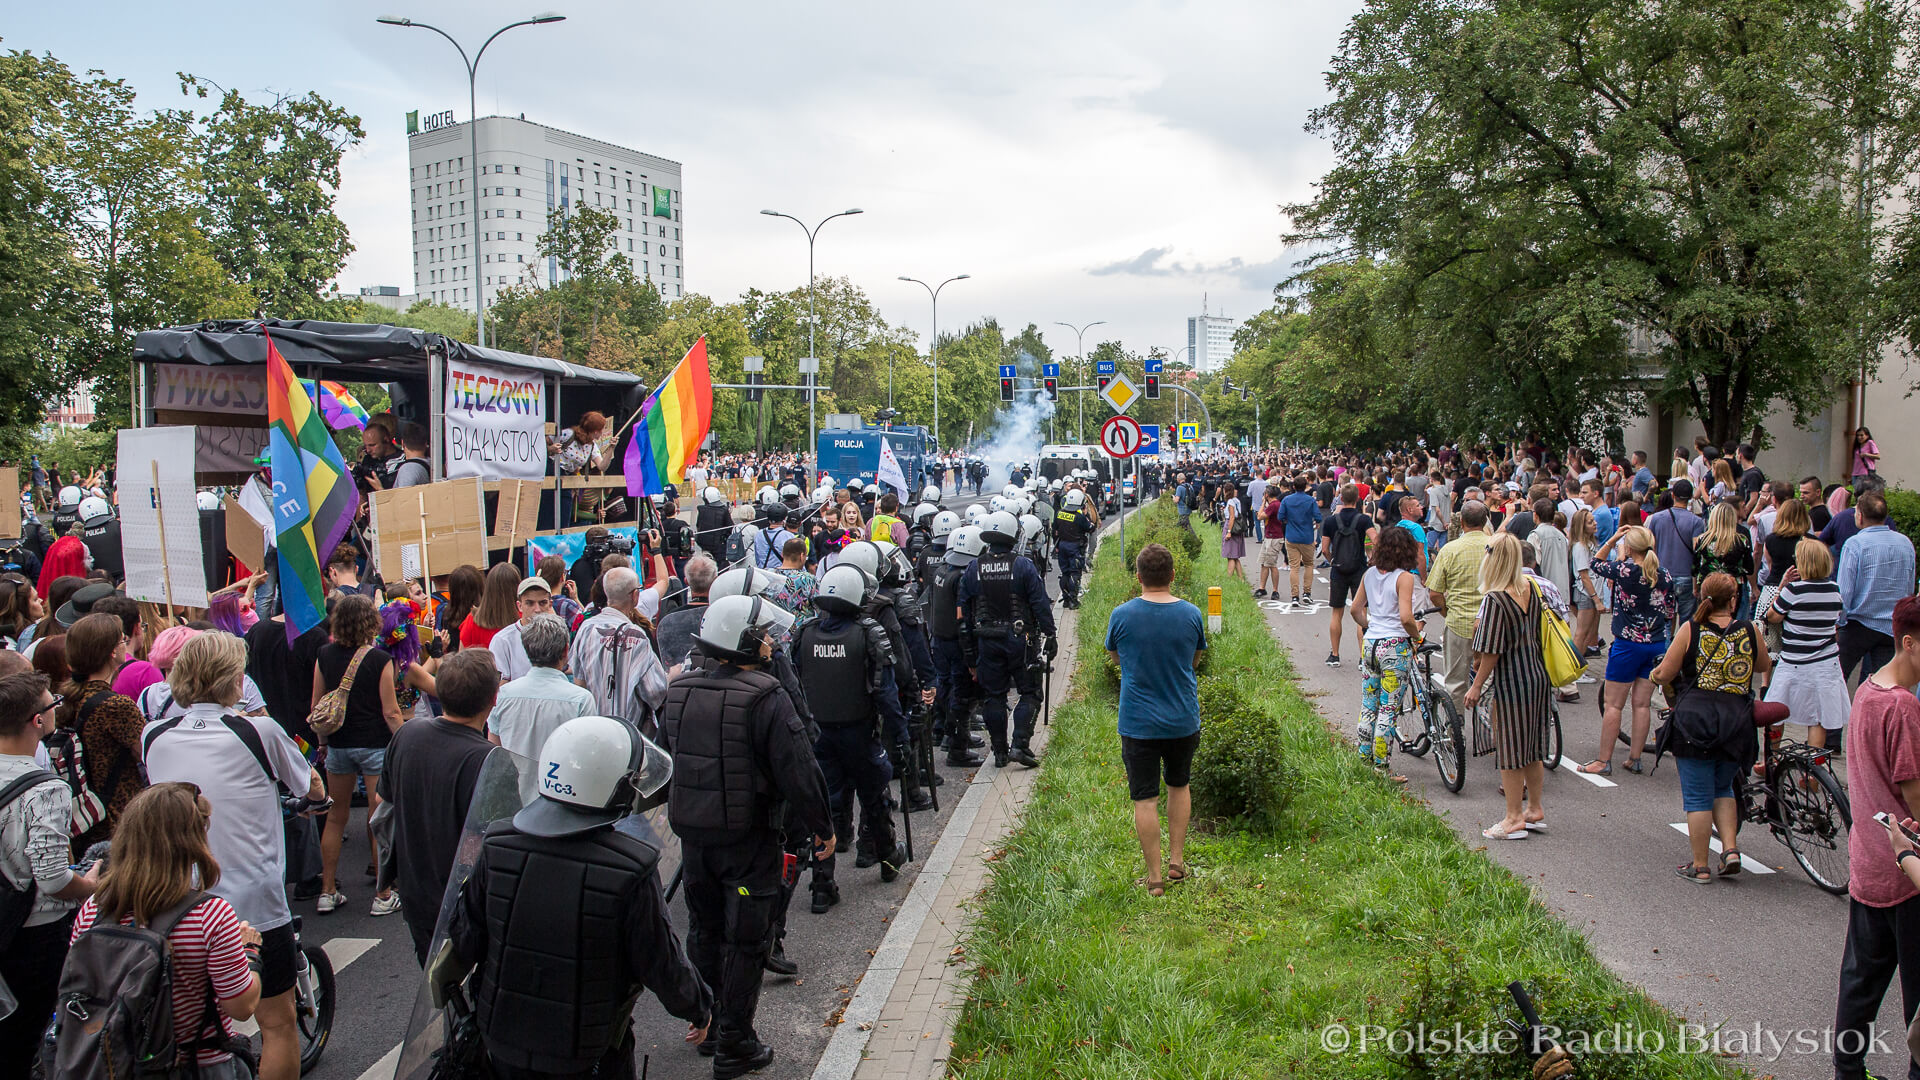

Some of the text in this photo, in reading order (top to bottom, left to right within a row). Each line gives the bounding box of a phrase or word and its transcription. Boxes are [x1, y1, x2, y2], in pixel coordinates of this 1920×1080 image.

[424, 109, 455, 131] HOTEL
[659, 225, 667, 297] HOTE
[453, 370, 541, 418] TĘCZOWY
[452, 426, 541, 462] BIAŁYSTOK
[834, 440, 864, 448] POLICJA
[981, 562, 1009, 573] POLICJA
[828, 586, 835, 594] Z
[814, 644, 846, 658] POLICJA
[547, 761, 560, 780] Z
